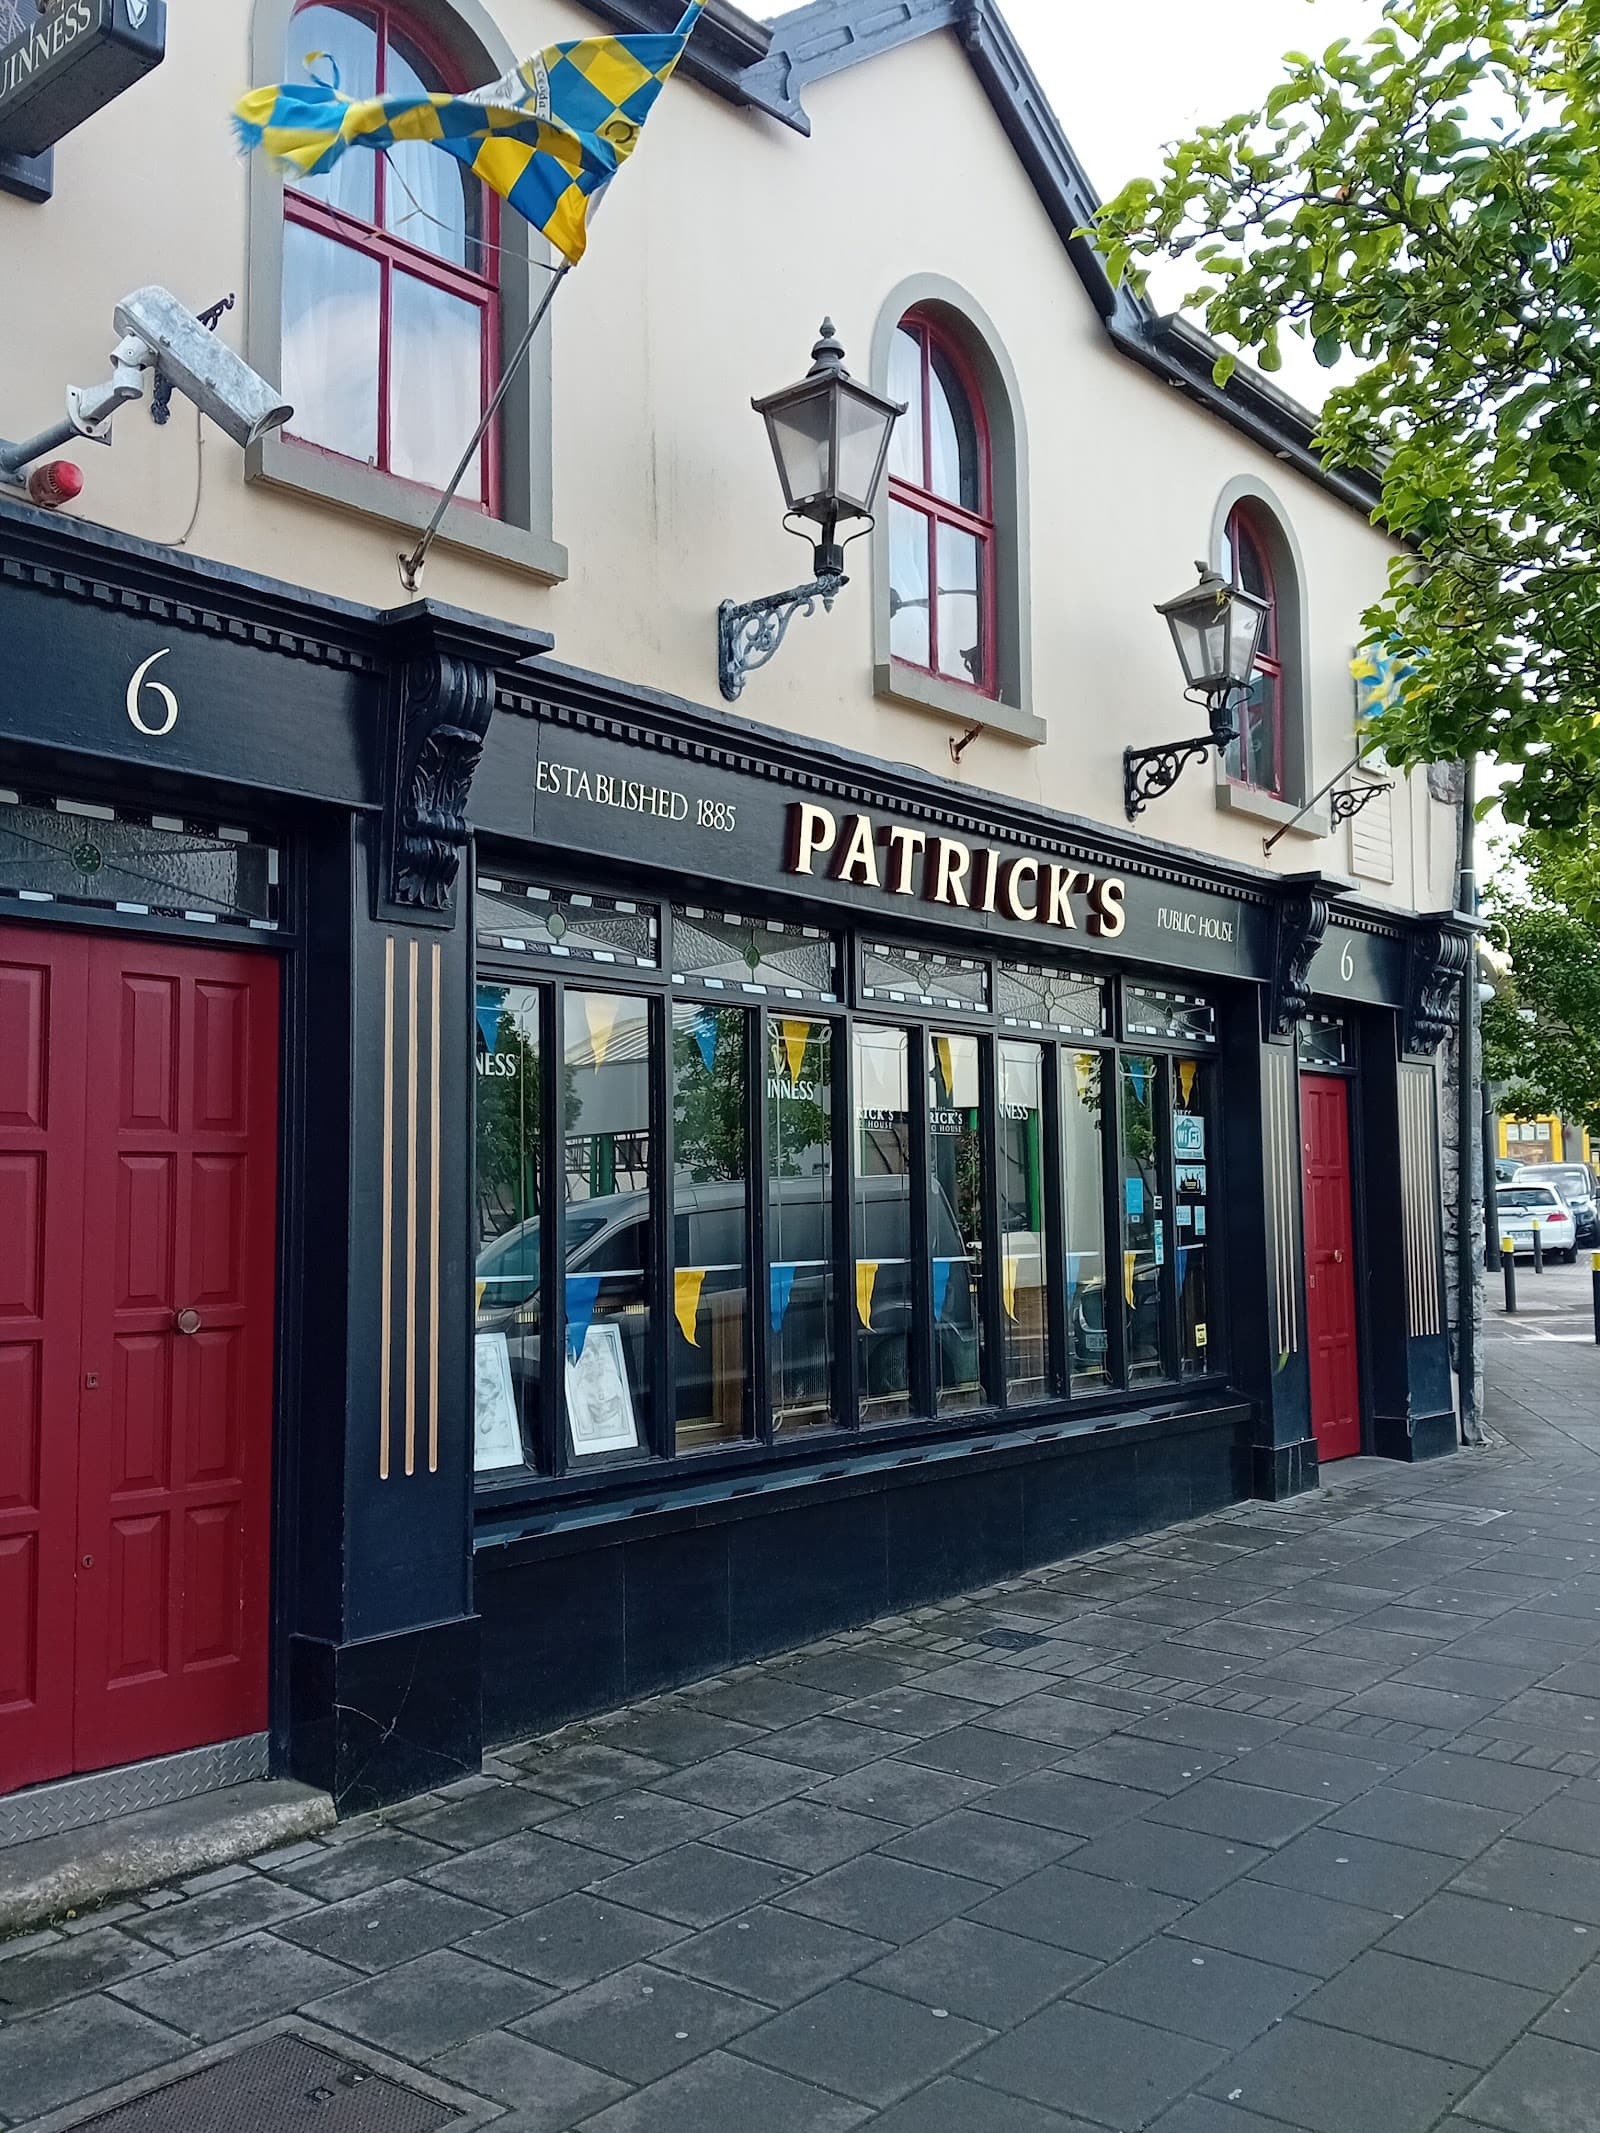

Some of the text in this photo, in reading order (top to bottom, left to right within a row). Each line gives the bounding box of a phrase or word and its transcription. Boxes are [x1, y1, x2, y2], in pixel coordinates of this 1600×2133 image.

[126, 647, 179, 735] 6
[536, 761, 737, 832] ESTABLISHED 1885
[788, 801, 1127, 938] PATRICK'S
[1157, 907, 1234, 943] PUBLIC HOUSE
[1341, 939, 1354, 981] 6
[867, 1120, 894, 1130] HOUSE
